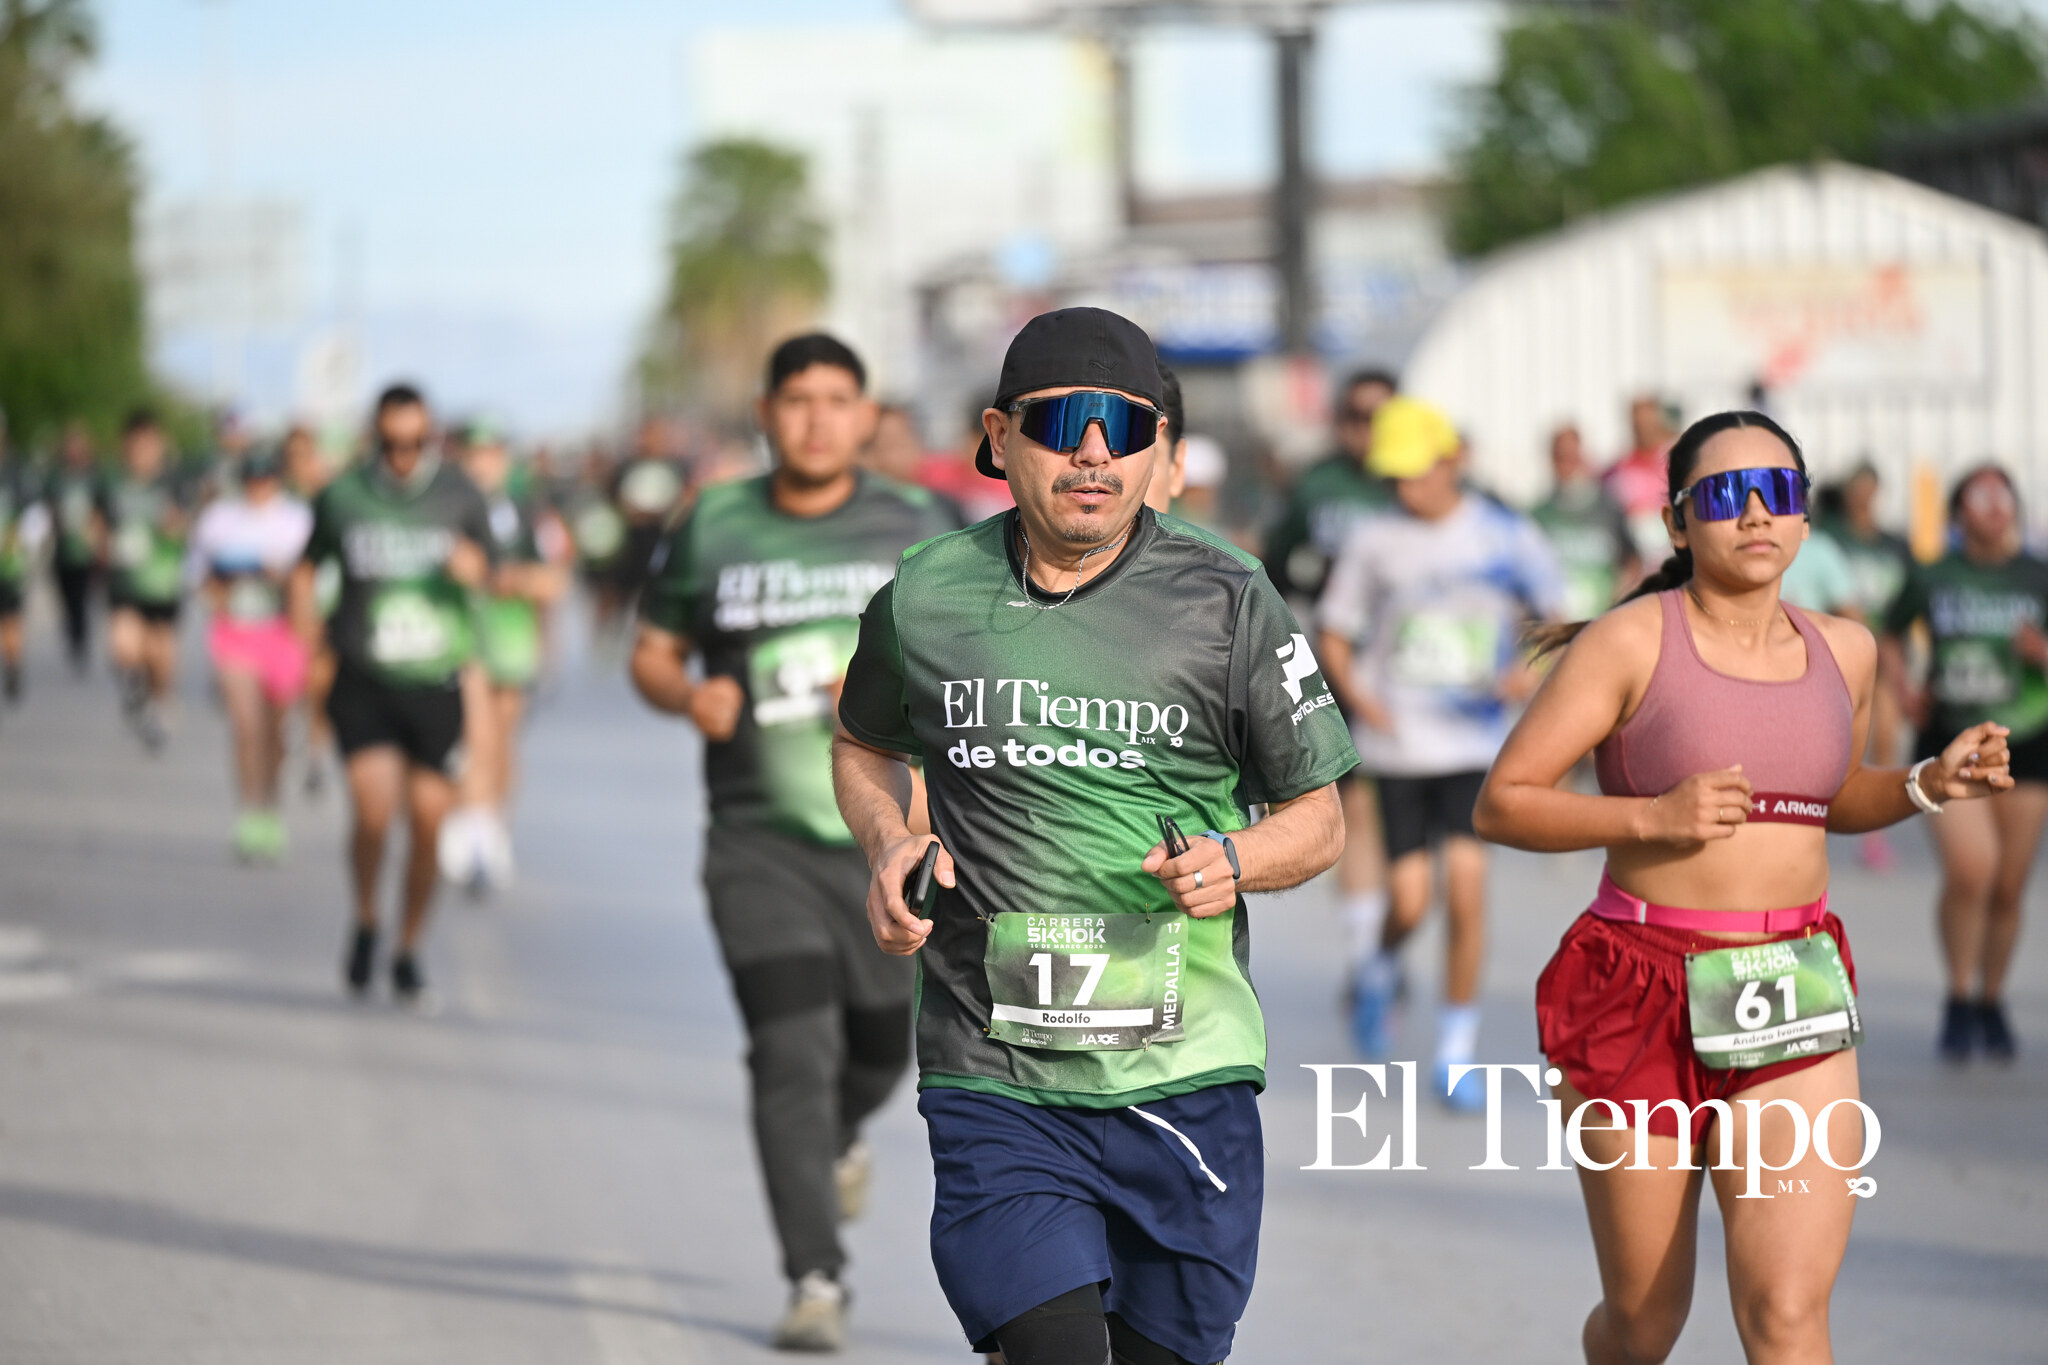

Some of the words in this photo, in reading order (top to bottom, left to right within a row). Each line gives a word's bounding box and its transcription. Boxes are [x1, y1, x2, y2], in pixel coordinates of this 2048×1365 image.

[940, 678, 988, 728] El
[996, 679, 1189, 746] Tiempo
[1141, 736, 1156, 745] MX
[947, 739, 996, 769] de
[1002, 738, 1146, 770] todos
[1027, 917, 1105, 927] CARRERA
[1167, 923, 1181, 934] 17
[1028, 952, 1110, 1006] 17
[1162, 943, 1180, 1030] MEDALLA
[1735, 974, 1797, 1031] 61
[1042, 1013, 1091, 1024] Rodolfo
[1733, 1033, 1774, 1046] Andrea
